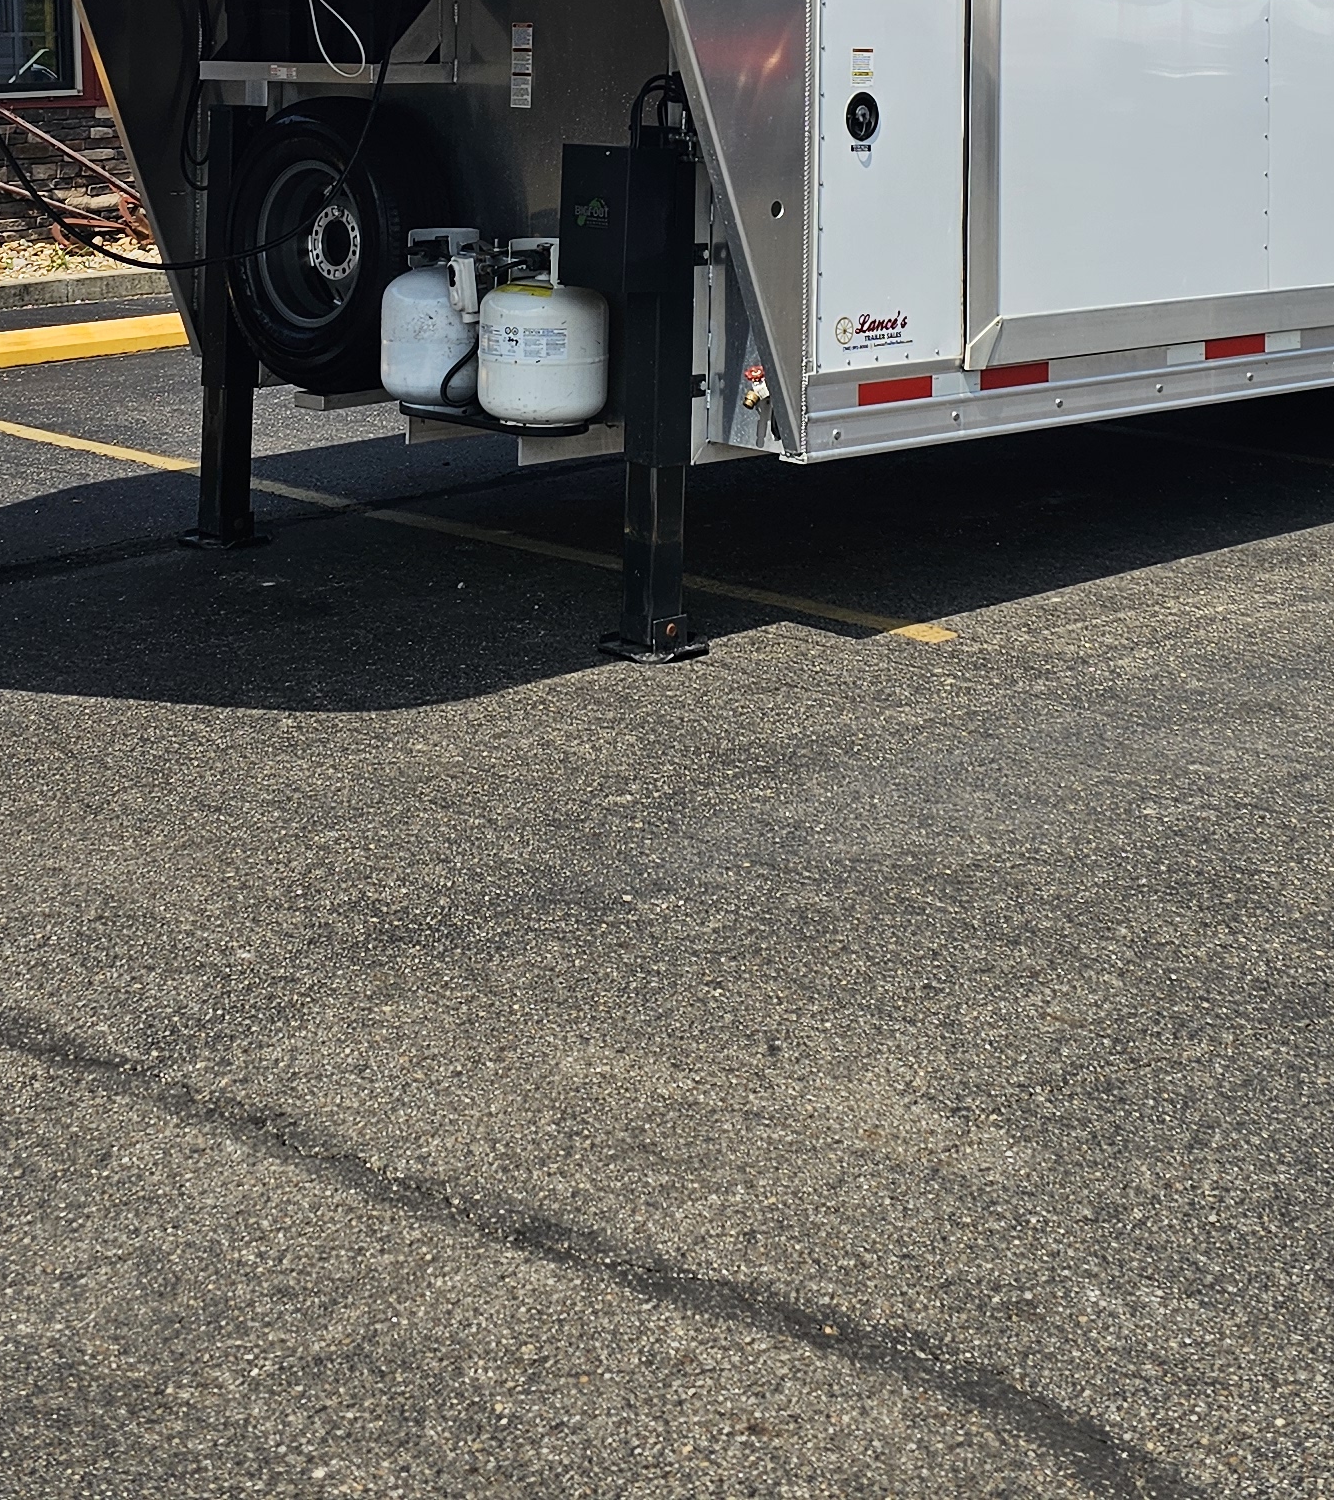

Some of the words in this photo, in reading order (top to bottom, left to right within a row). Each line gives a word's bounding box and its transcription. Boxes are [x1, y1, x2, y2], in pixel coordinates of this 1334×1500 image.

[574, 204, 609, 218] BIGFOOT
[854, 310, 908, 334] Lance's
[864, 333, 886, 342] TRAILER
[886, 331, 902, 340] SALES
